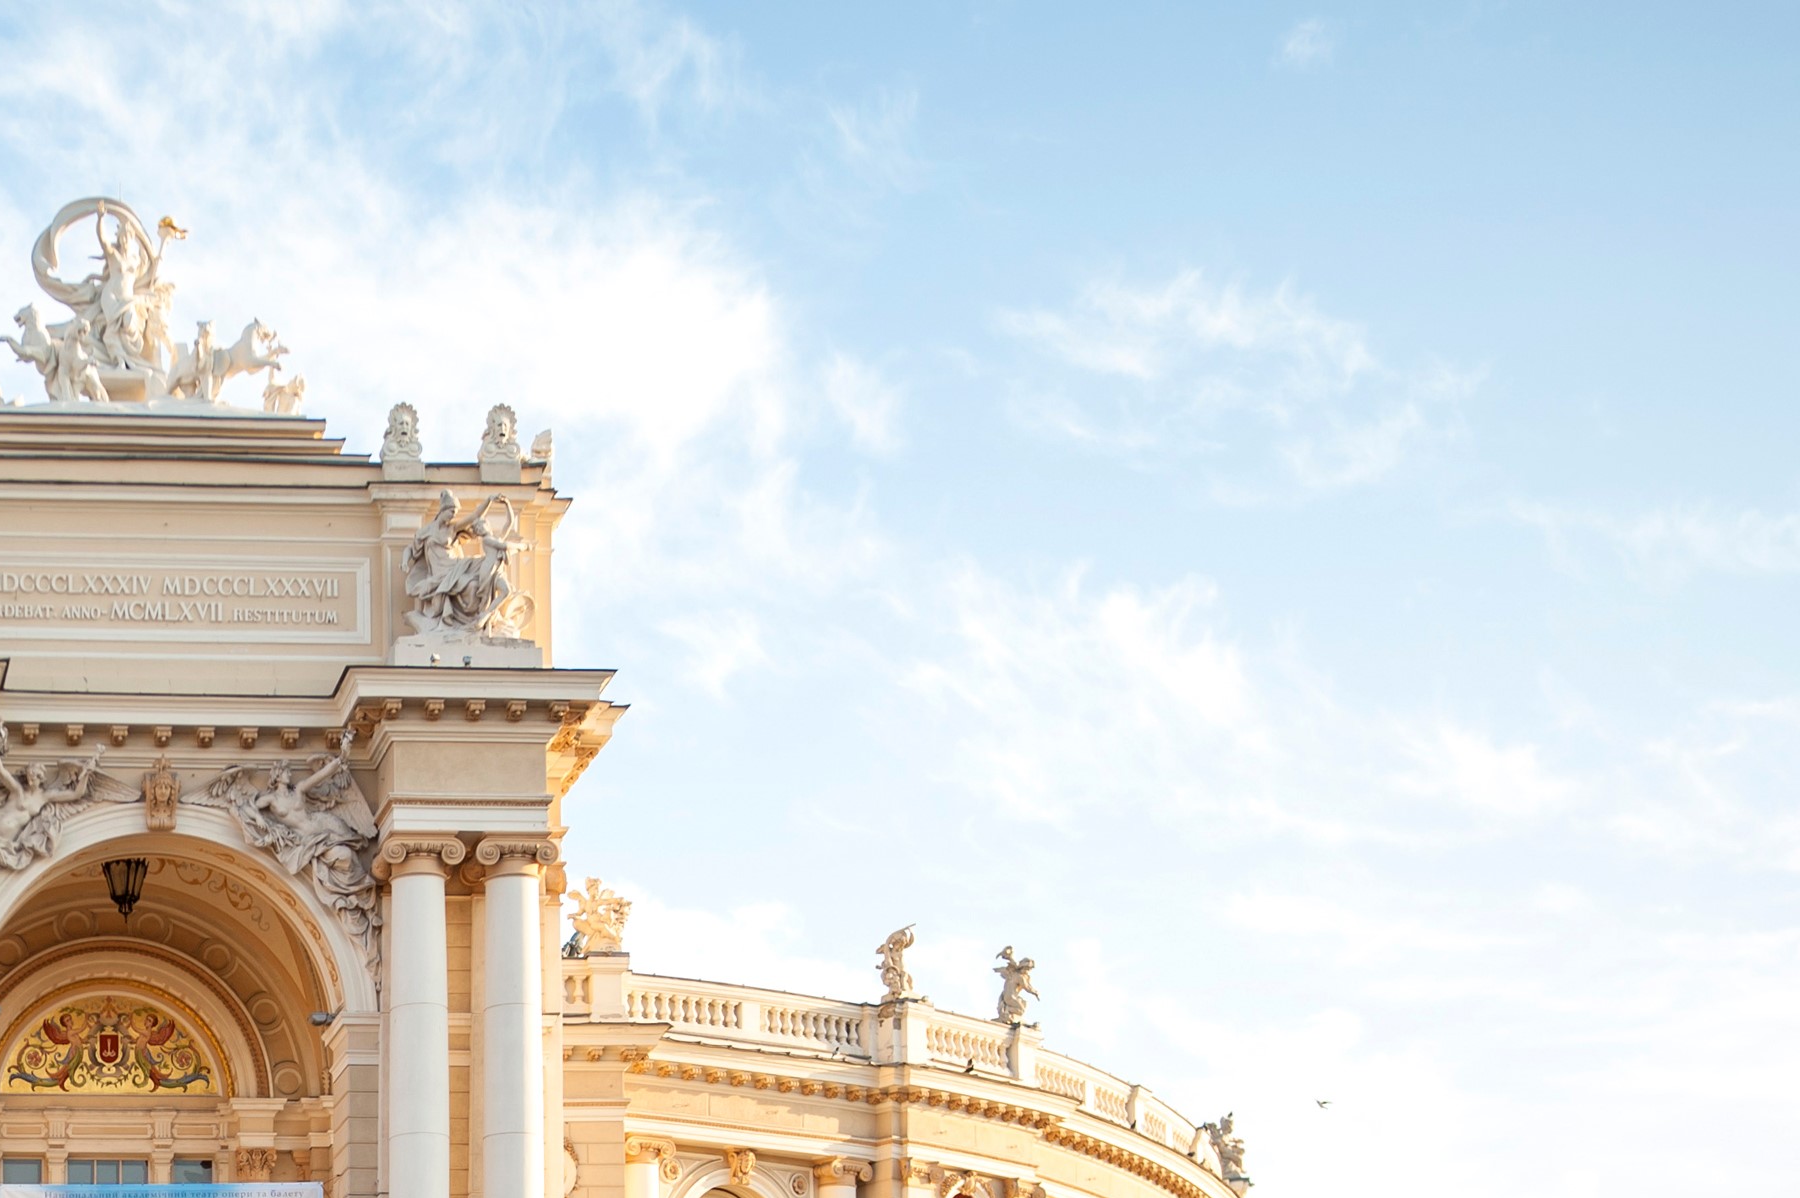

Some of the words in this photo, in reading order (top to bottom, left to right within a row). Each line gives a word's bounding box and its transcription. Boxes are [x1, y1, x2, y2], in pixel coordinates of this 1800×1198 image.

[162, 576, 339, 597] MDCCCLXXXVII
[110, 600, 224, 622] MCMLXVII
[233, 607, 338, 624] RESTITUTUM
[45, 1191, 119, 1198] Національний
[122, 1190, 187, 1198] академічний
[257, 1190, 267, 1198] та
